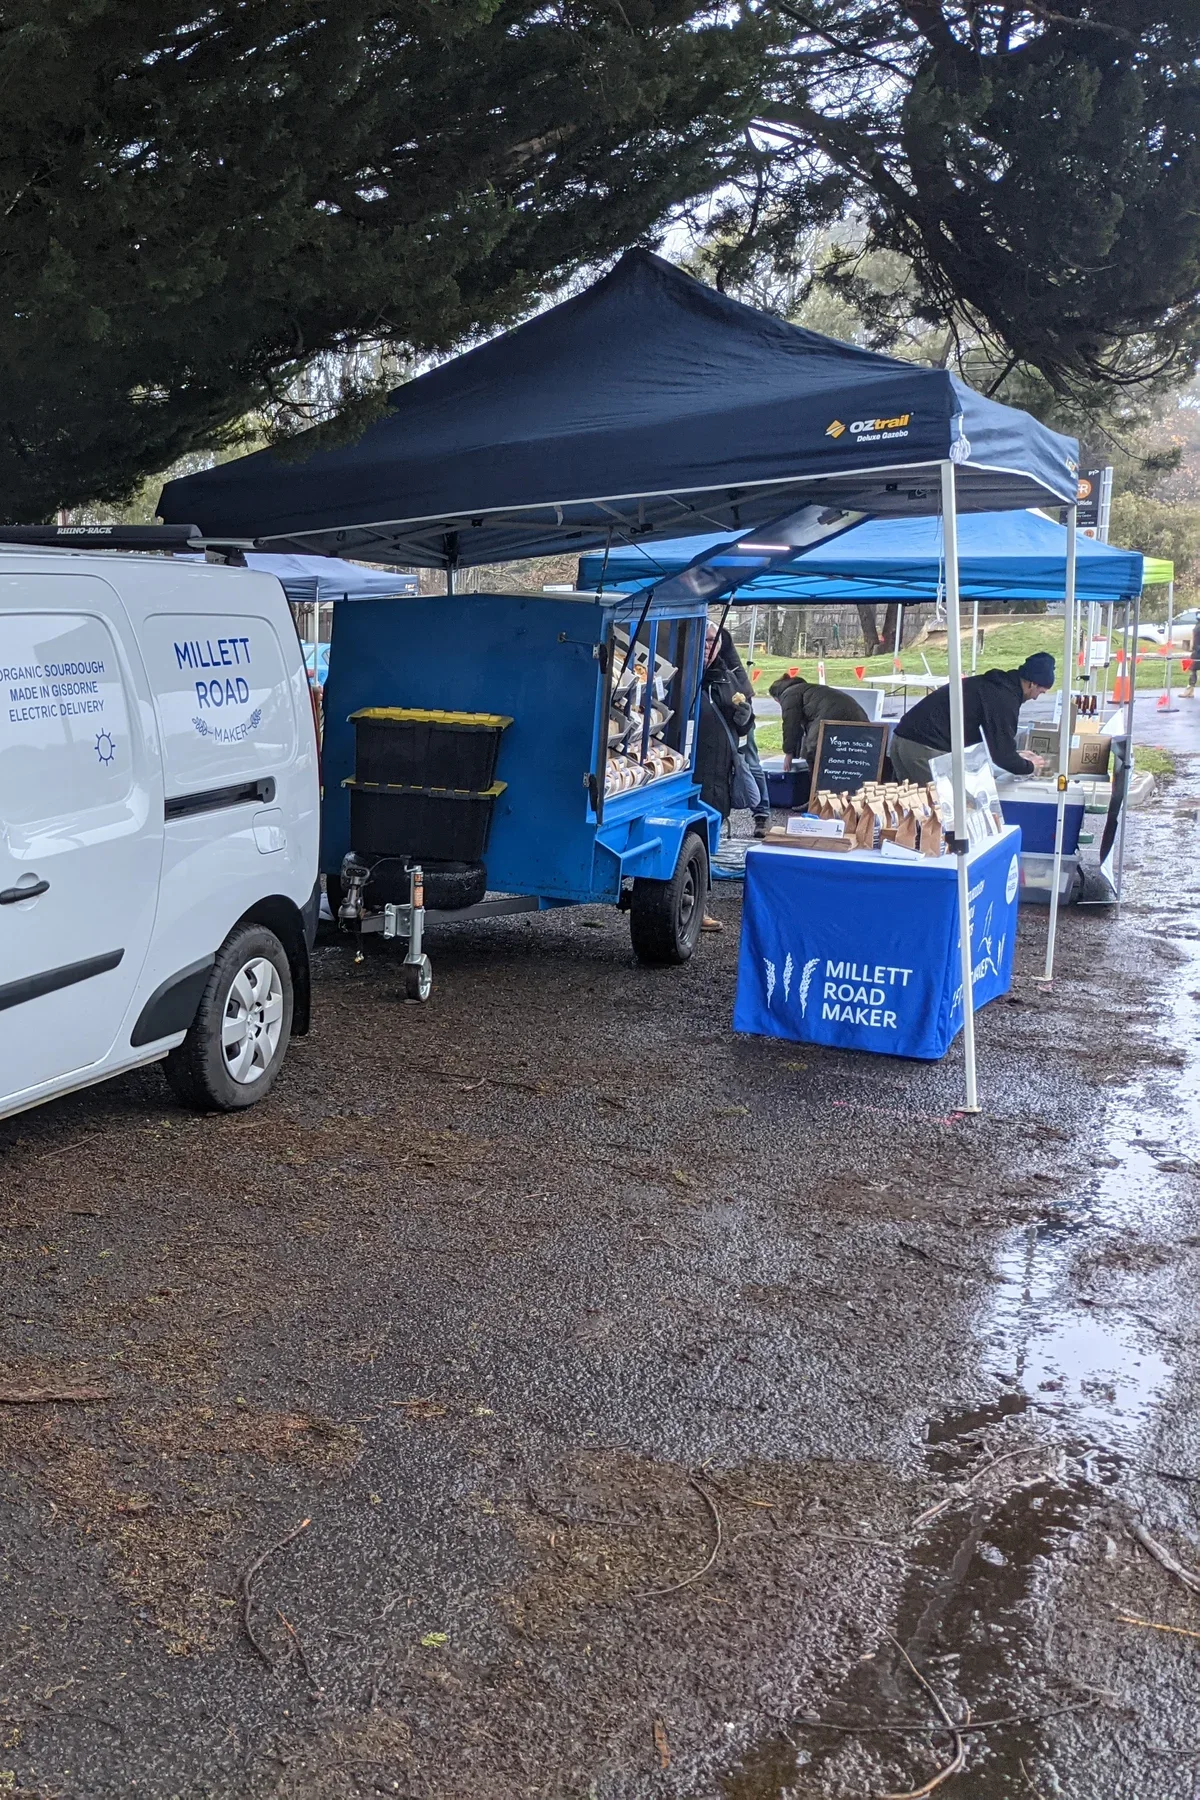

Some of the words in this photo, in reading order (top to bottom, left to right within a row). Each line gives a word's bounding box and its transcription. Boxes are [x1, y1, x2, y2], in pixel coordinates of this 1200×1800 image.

[849, 414, 910, 433] OZtrail
[857, 434, 880, 442] Deluxe
[882, 430, 908, 439] Gazebo
[57, 527, 113, 535] RHINO-RACK
[174, 638, 250, 669] MILLETT
[44, 661, 105, 678] SOURDOUGH
[10, 686, 38, 702] MADE
[40, 685, 50, 698] IN
[51, 681, 99, 697] GISBORNE
[195, 677, 249, 709] ROAD
[9, 704, 58, 722] ELECTRIC
[60, 700, 104, 716] DELIVERY
[214, 723, 248, 742] MAKER
[830, 736, 850, 747] Vegan
[825, 960, 913, 987] MILLETT
[823, 982, 885, 1006] ROAD
[822, 1002, 897, 1029] MAKER
